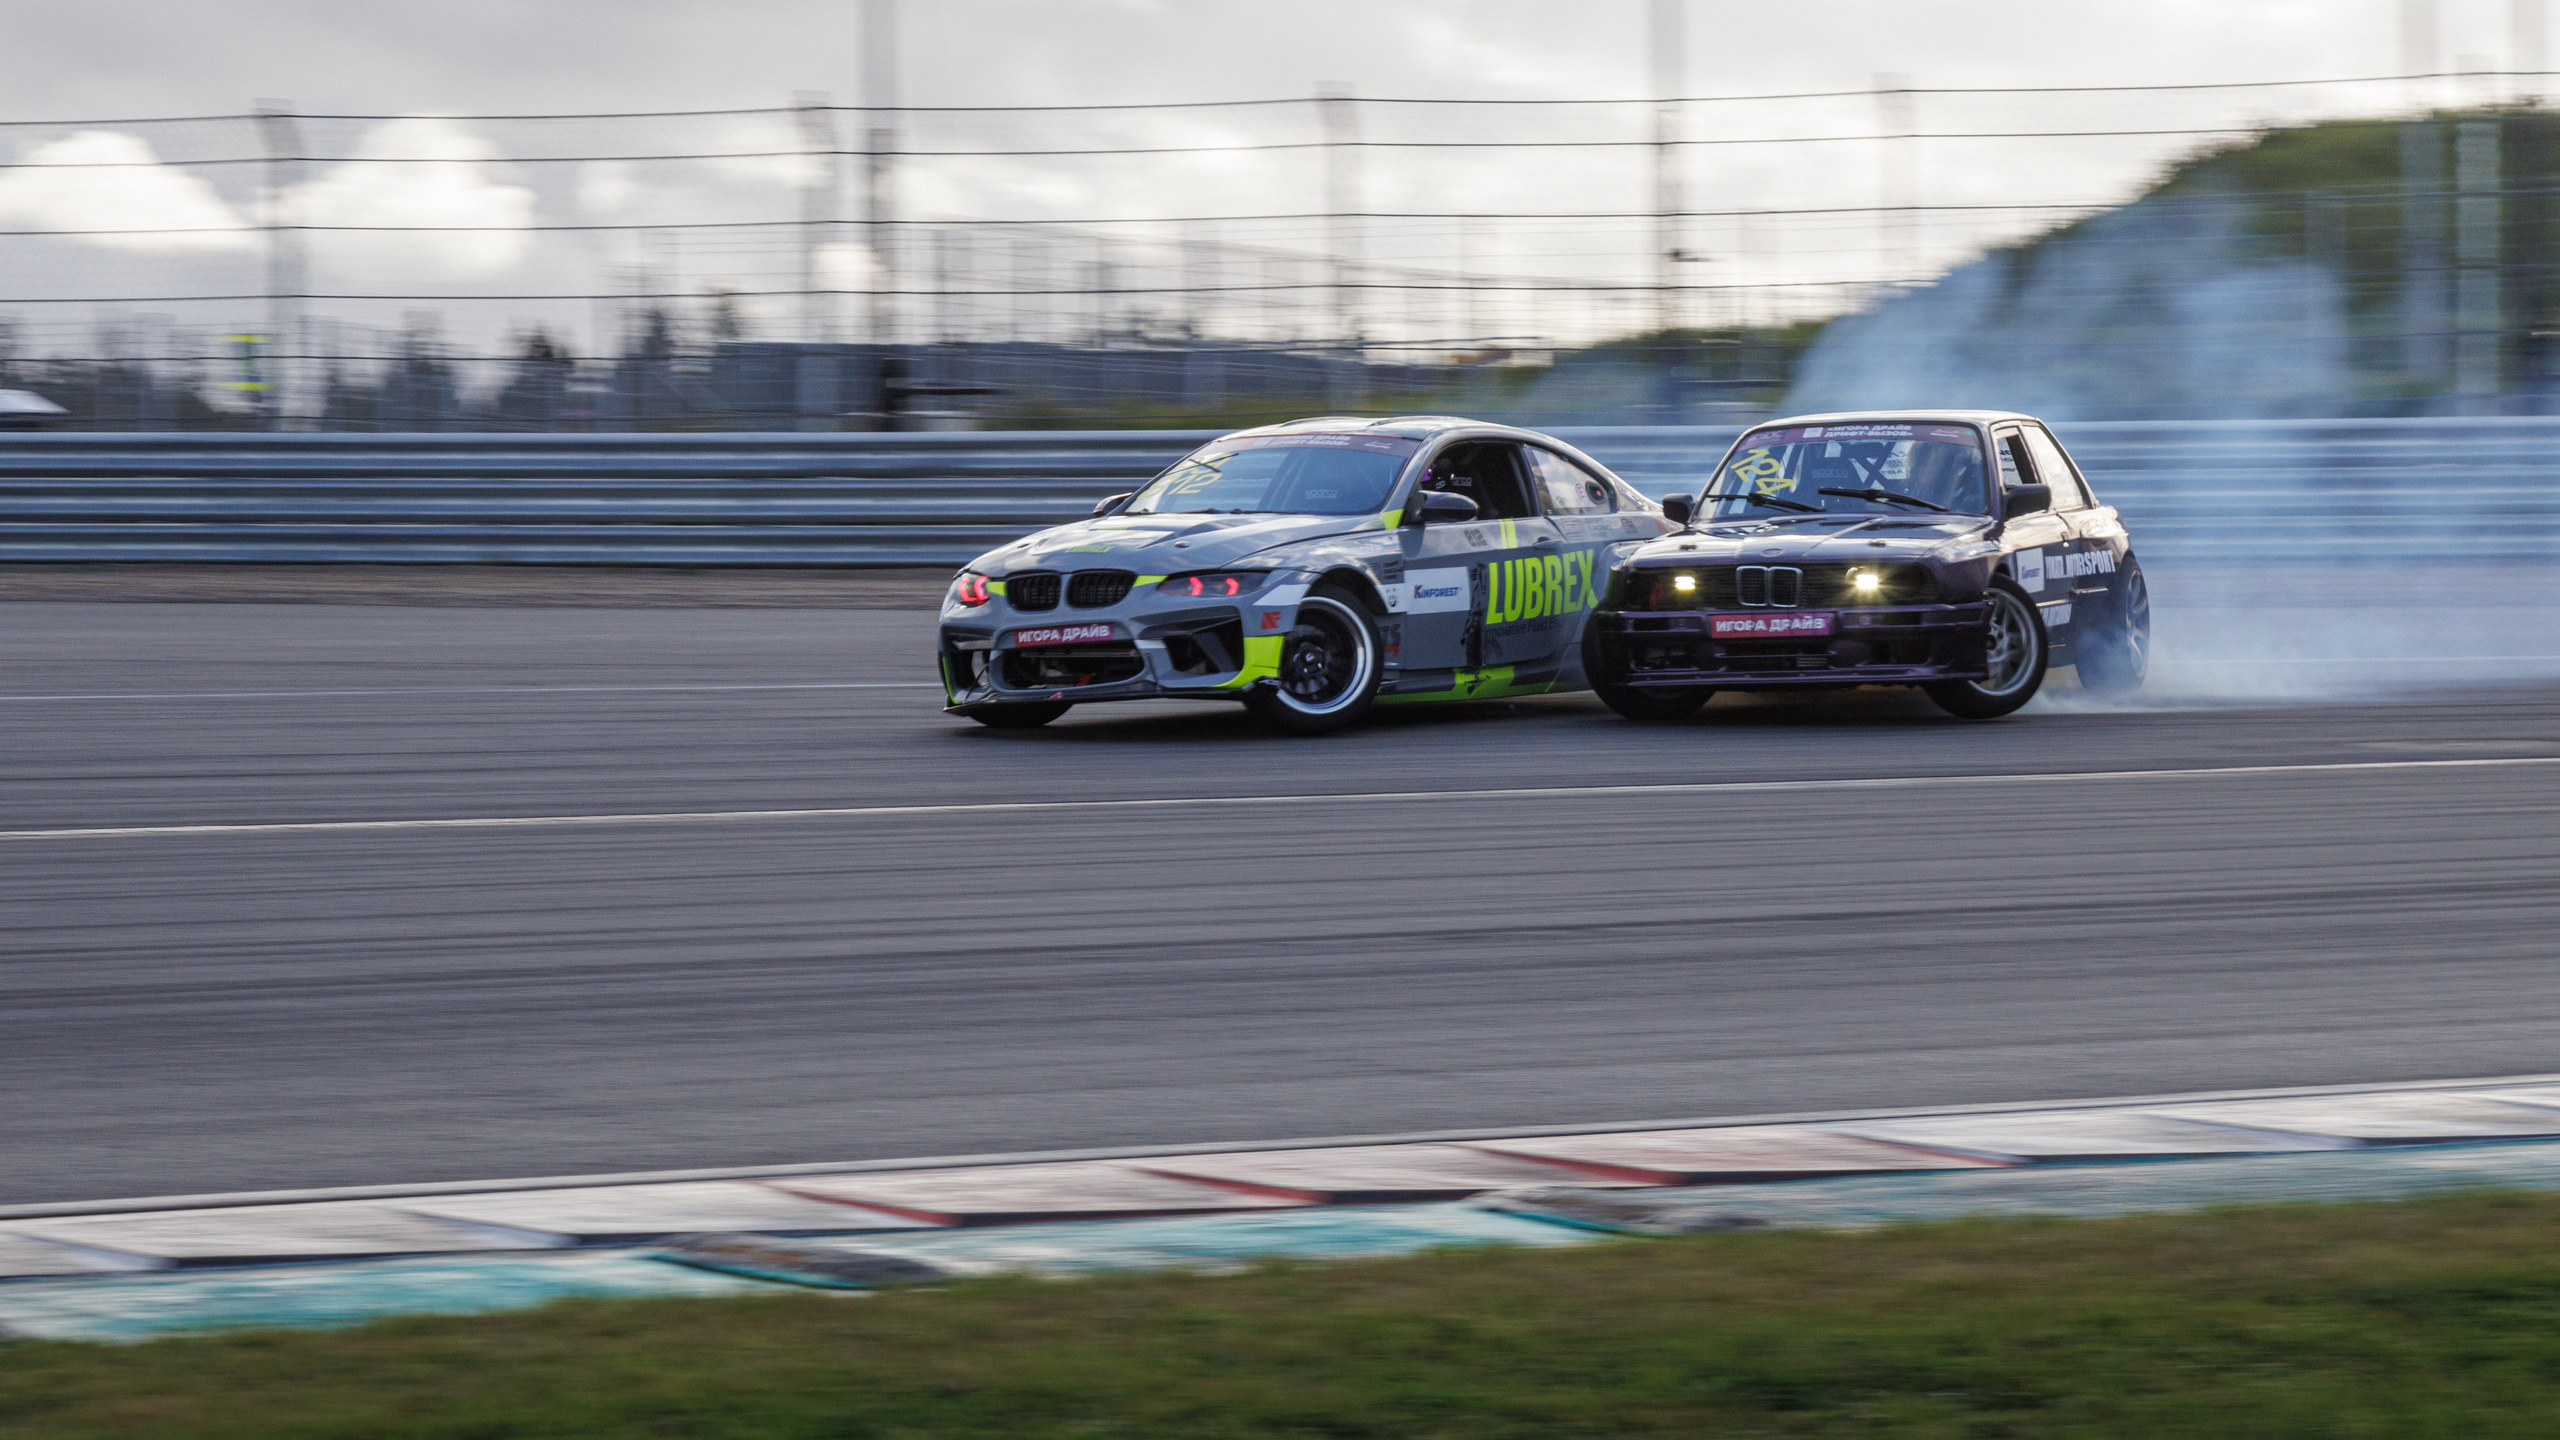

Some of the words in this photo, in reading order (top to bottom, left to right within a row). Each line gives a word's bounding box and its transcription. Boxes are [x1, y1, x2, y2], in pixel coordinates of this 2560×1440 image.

[1485, 549, 1599, 625] LUBREX
[1018, 628, 1060, 644] ИГОРА
[1061, 624, 1110, 642] ДРАЙВ
[1716, 619, 1767, 633] ИГОРА
[1769, 615, 1826, 633] ДРАЙВ
